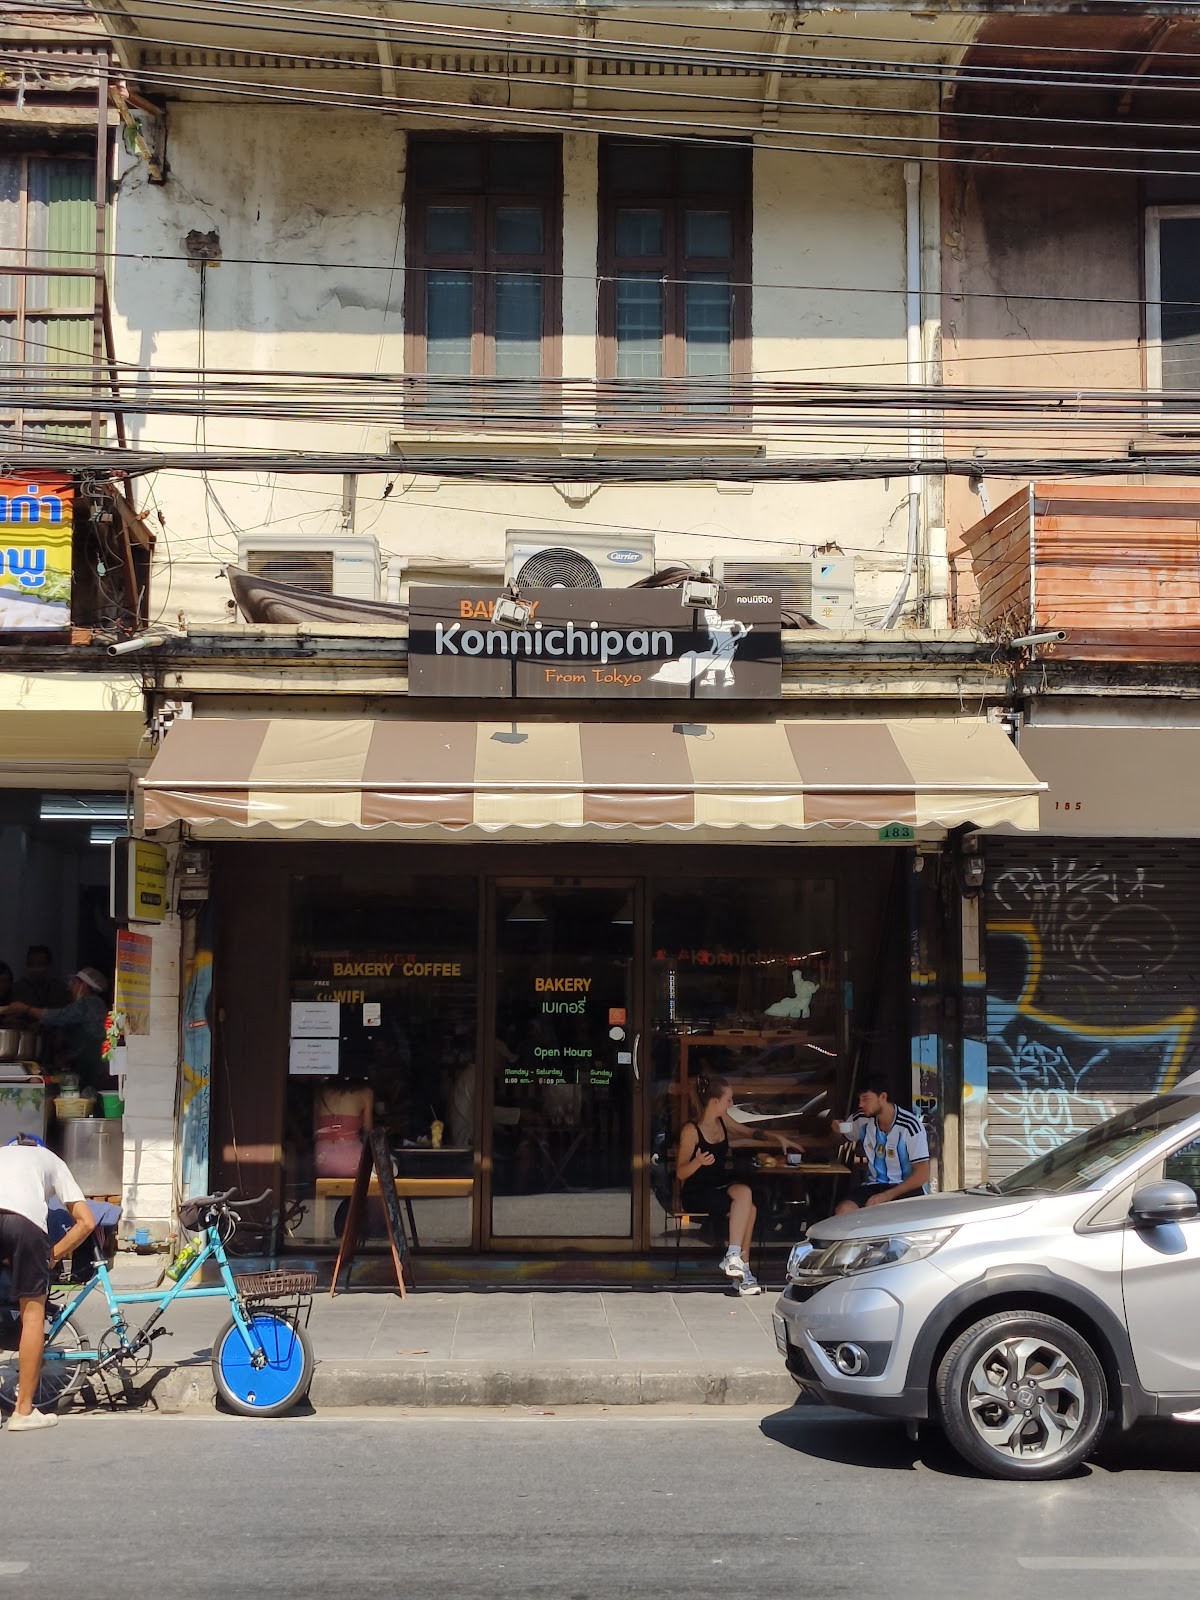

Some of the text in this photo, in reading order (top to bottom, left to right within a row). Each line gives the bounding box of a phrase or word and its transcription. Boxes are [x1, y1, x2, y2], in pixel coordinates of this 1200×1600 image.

[610, 552, 641, 561] Carrier
[0, 547, 46, 587] พู
[435, 621, 674, 664] Konnichipan
[544, 667, 643, 687] From Tokyo
[884, 827, 910, 838] 183
[333, 962, 462, 977] BAKERY COFFEE
[535, 977, 592, 992] BAKERY
[333, 990, 365, 1004] WIFI
[534, 1046, 593, 1060] Open Hours
[504, 1067, 529, 1077] Monday
[590, 1069, 613, 1077] Sunday
